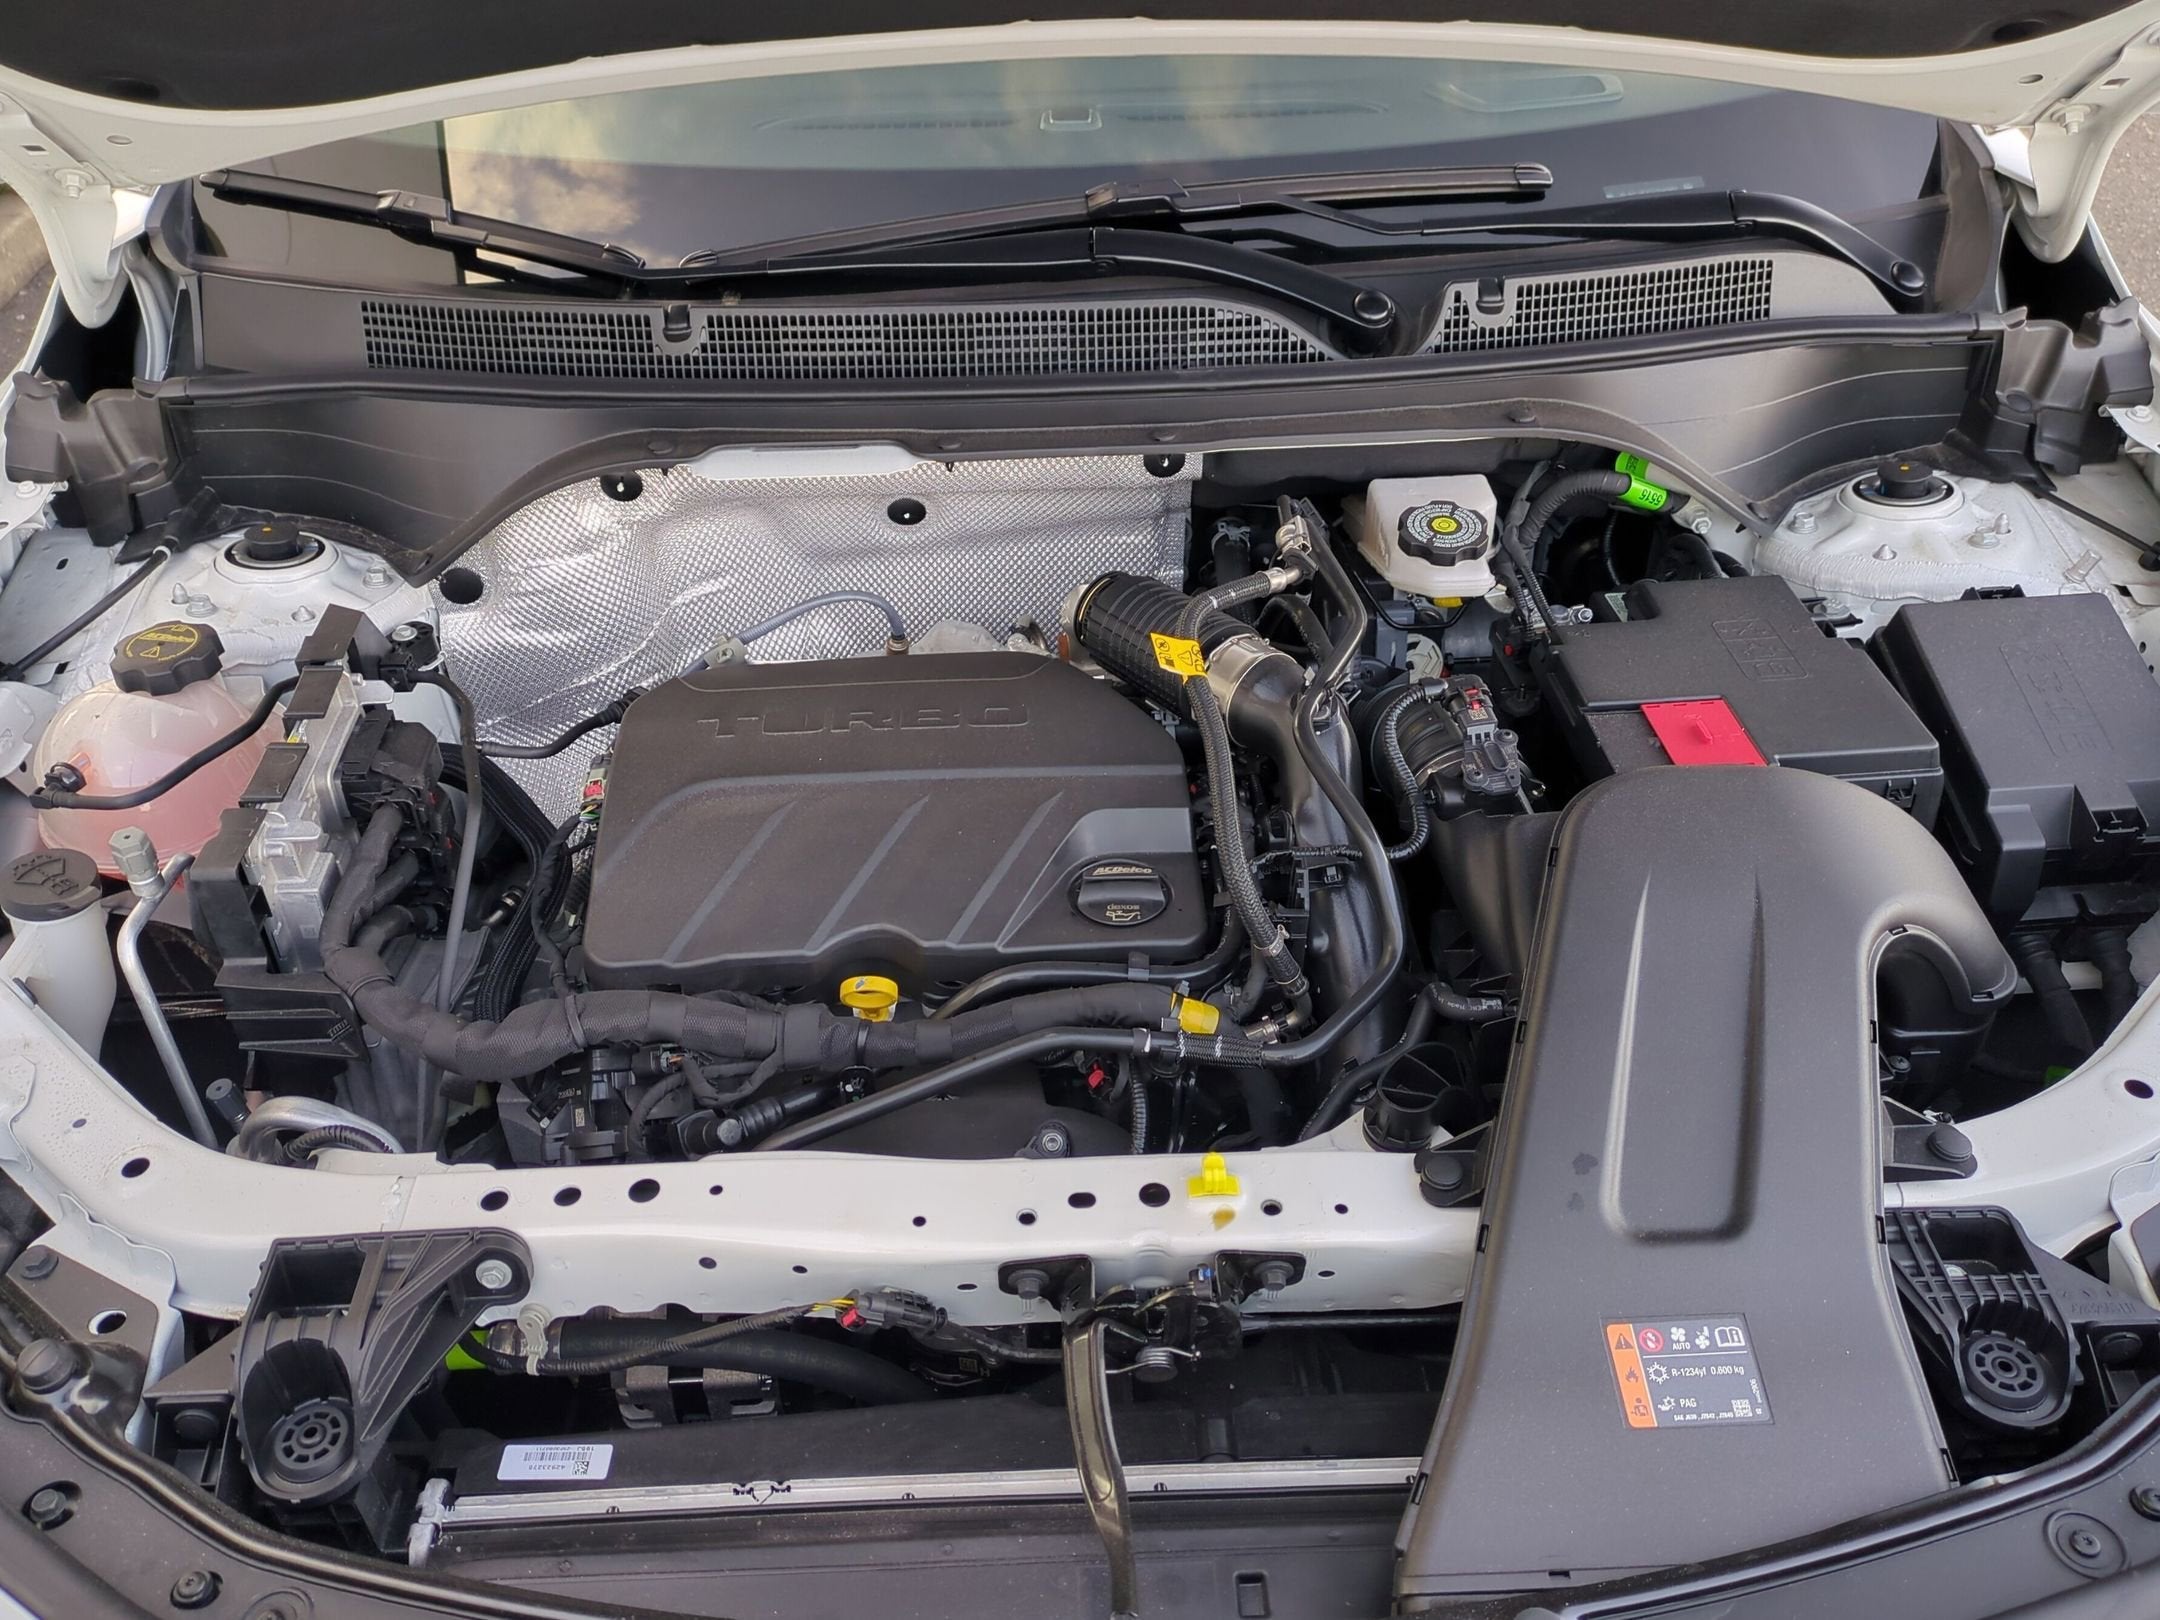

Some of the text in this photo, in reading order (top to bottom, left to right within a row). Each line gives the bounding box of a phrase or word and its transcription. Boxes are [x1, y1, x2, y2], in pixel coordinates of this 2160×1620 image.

[696, 702, 1031, 738] TURBO
[1092, 865, 1153, 876] ACDelco
[1672, 1342, 1691, 1351] AUTO
[1710, 1366, 1732, 1375] 0.600
[1733, 1365, 1745, 1376] kg
[1679, 1398, 1697, 1408] PAG
